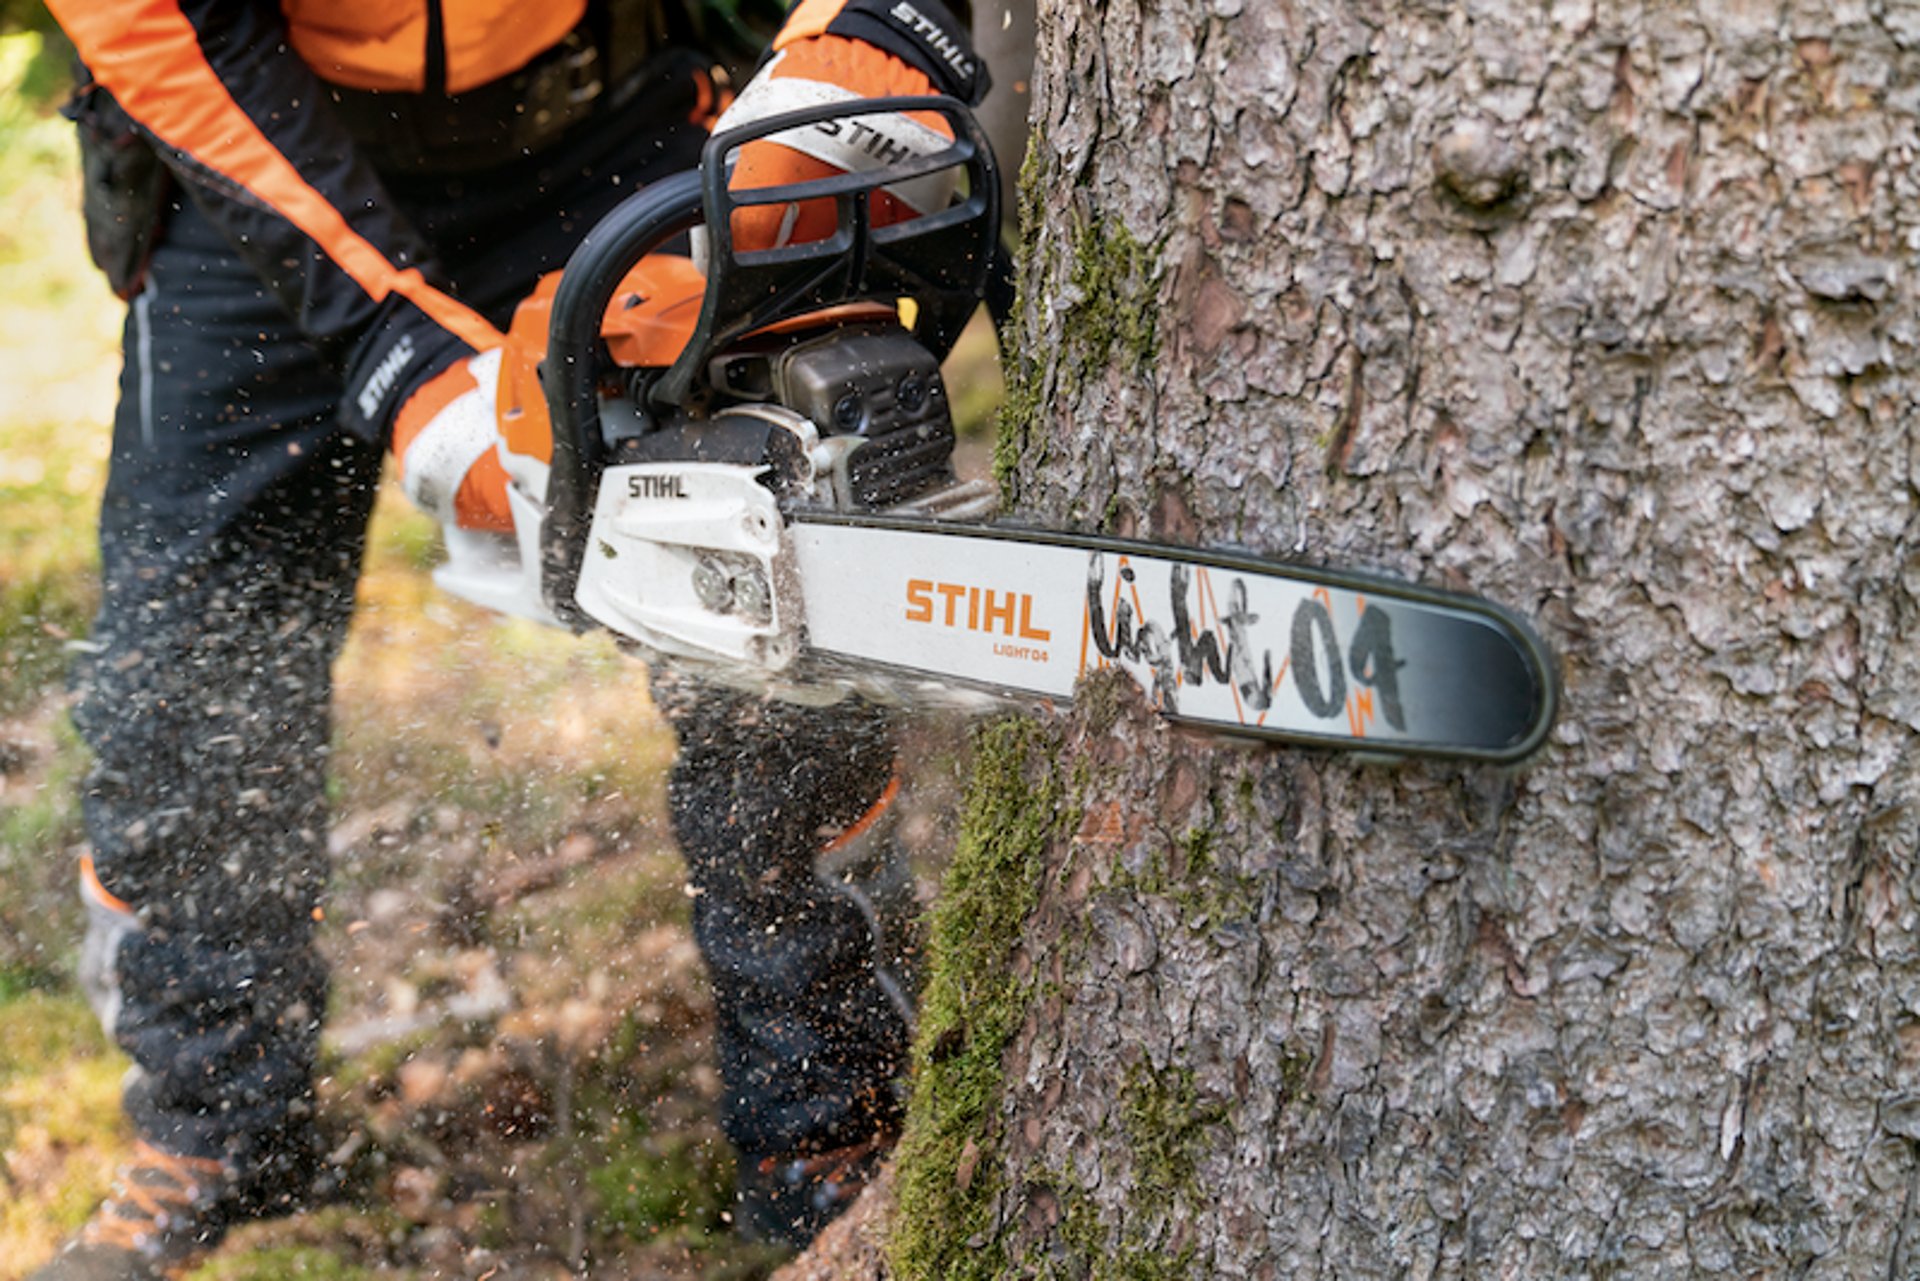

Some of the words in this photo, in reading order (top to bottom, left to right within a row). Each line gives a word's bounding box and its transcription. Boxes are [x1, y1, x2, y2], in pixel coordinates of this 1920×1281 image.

[890, 2, 973, 79] STIHL
[814, 119, 920, 166] STIH
[628, 474, 690, 499] STIHL
[905, 578, 1051, 642] STIHL
[993, 642, 1030, 660] LIGHT
[1031, 649, 1049, 663] 04
